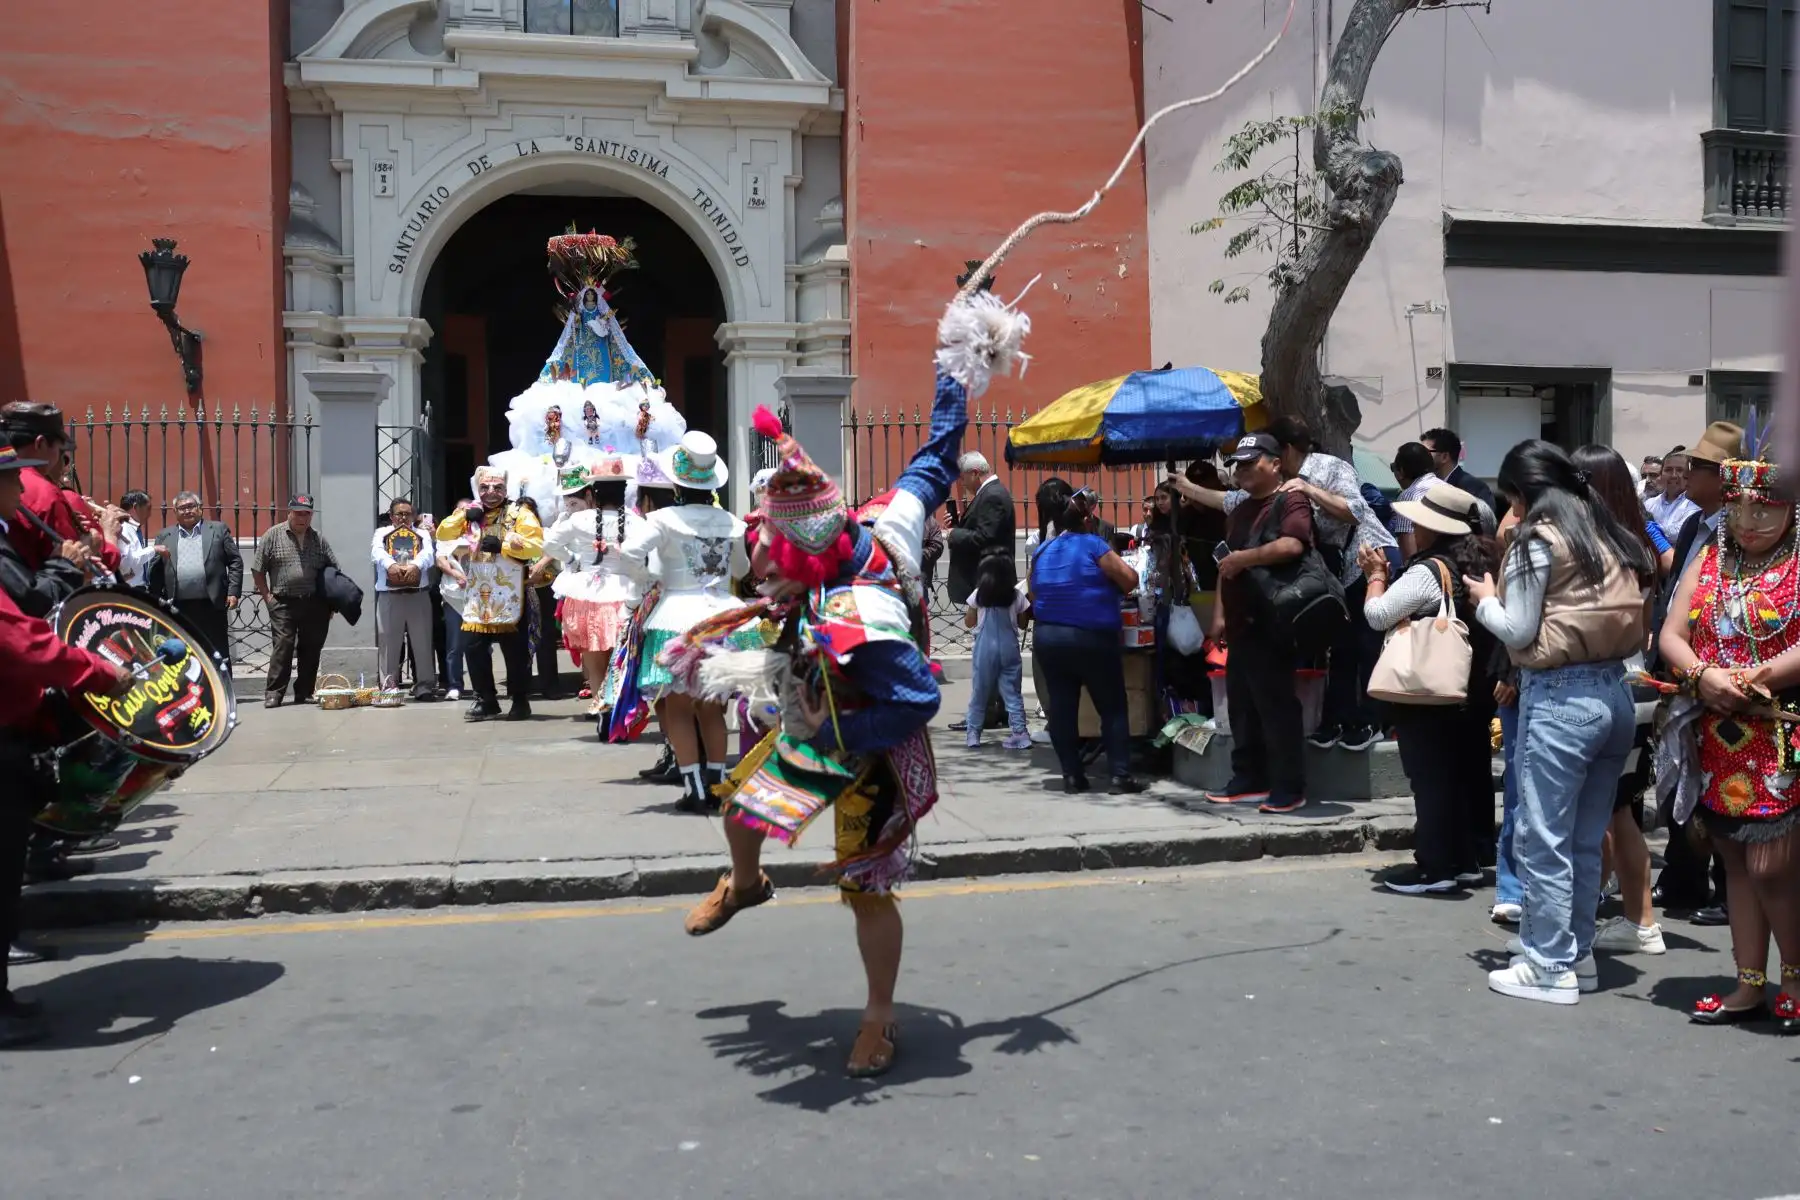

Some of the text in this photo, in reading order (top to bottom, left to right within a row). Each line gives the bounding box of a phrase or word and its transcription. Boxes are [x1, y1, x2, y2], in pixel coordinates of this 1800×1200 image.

[389, 186, 450, 274] SANTUARIO
[467, 154, 494, 177] DE
[516, 139, 541, 157] LA
[692, 188, 749, 267] TRINIDAD
[752, 176, 759, 184] 2
